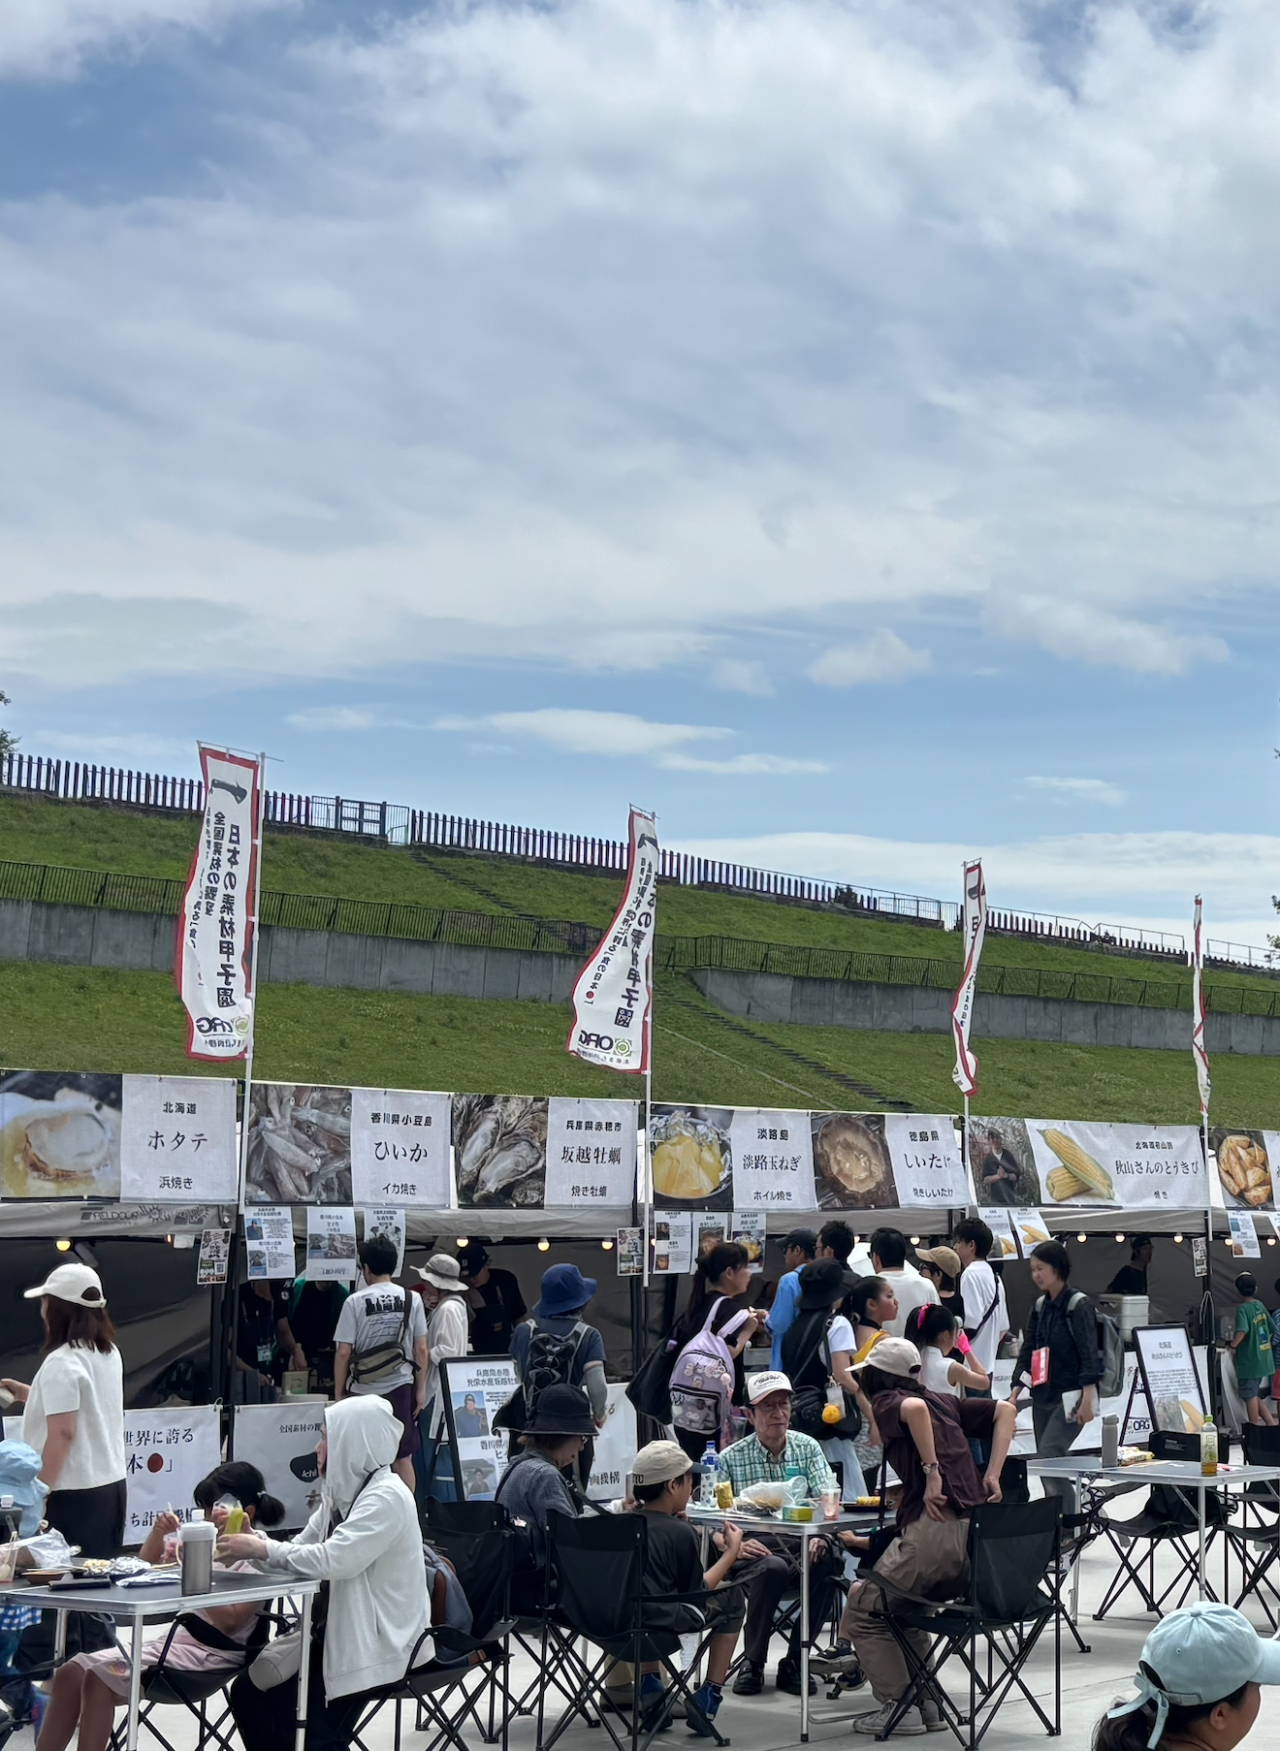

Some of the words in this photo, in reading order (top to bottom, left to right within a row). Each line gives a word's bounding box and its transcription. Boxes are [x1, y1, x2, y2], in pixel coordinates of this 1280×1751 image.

[163, 1101, 197, 1115] 北海道
[371, 1112, 432, 1127] 香川県小豆島
[566, 1120, 622, 1132] 兵庫県赤穂市
[148, 1131, 208, 1152] ホタテ
[757, 1128, 789, 1141] 淡路島
[909, 1130, 940, 1142] 徳島県
[374, 1141, 428, 1163] ひいか
[561, 1146, 622, 1165] 坂越牡蠣
[743, 1154, 802, 1171] 淡路玉ねぎ
[904, 1153, 951, 1169] しいたけ
[1115, 1160, 1199, 1175] 秋山さんのとうきび
[159, 1176, 193, 1189] 浜焼き
[382, 1183, 417, 1196] イカ焼き
[571, 1185, 607, 1197] 焼き牡蠣
[753, 1191, 792, 1201] ホイル焼き
[124, 1428, 194, 1447] 世界に誇る
